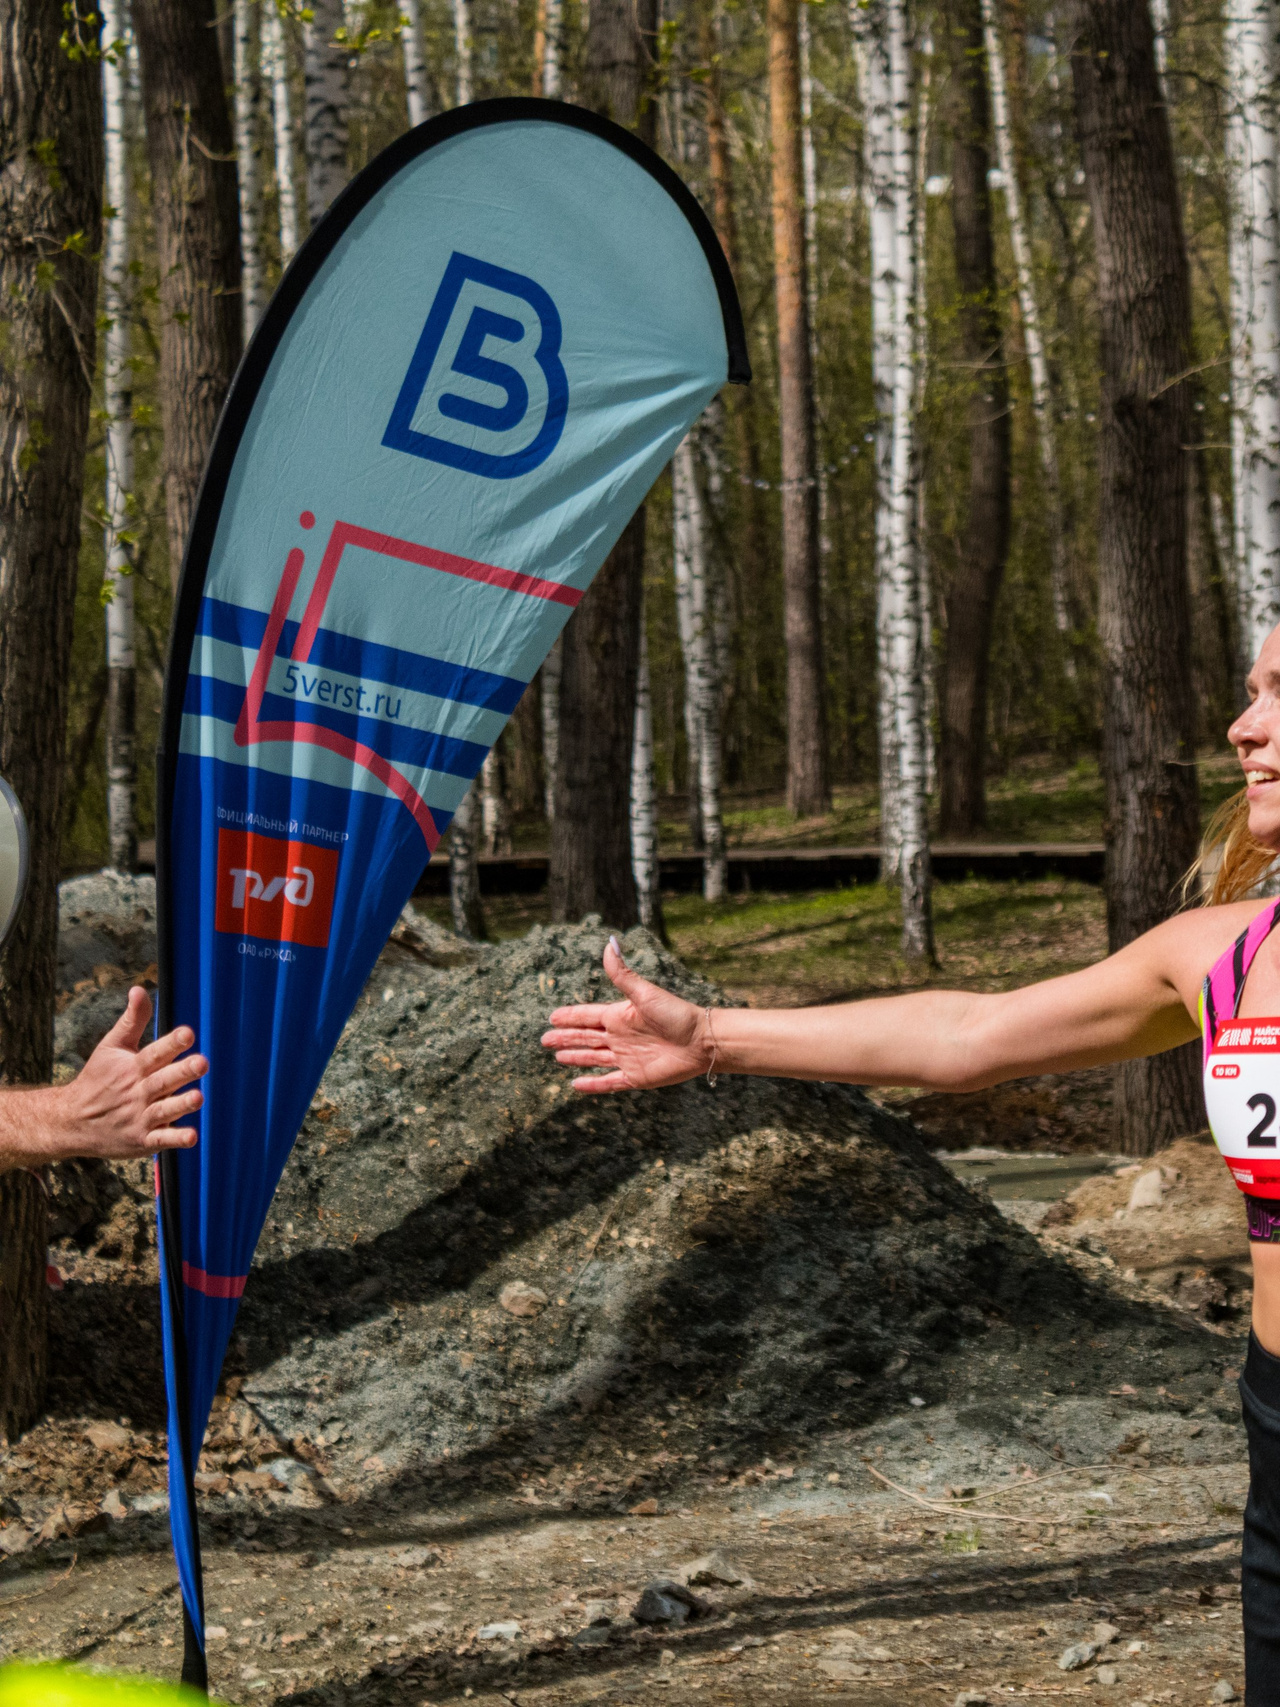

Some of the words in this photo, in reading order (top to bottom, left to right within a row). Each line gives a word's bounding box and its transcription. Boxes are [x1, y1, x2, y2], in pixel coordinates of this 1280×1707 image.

[282, 664, 402, 720] 5verst.ru
[216, 806, 299, 834] ОФИЦИАЛЬНЫЙ
[301, 823, 349, 844] ПАРТНЕР
[1252, 1036, 1278, 1046] ГРОЗА
[1215, 1067, 1224, 1076] 10
